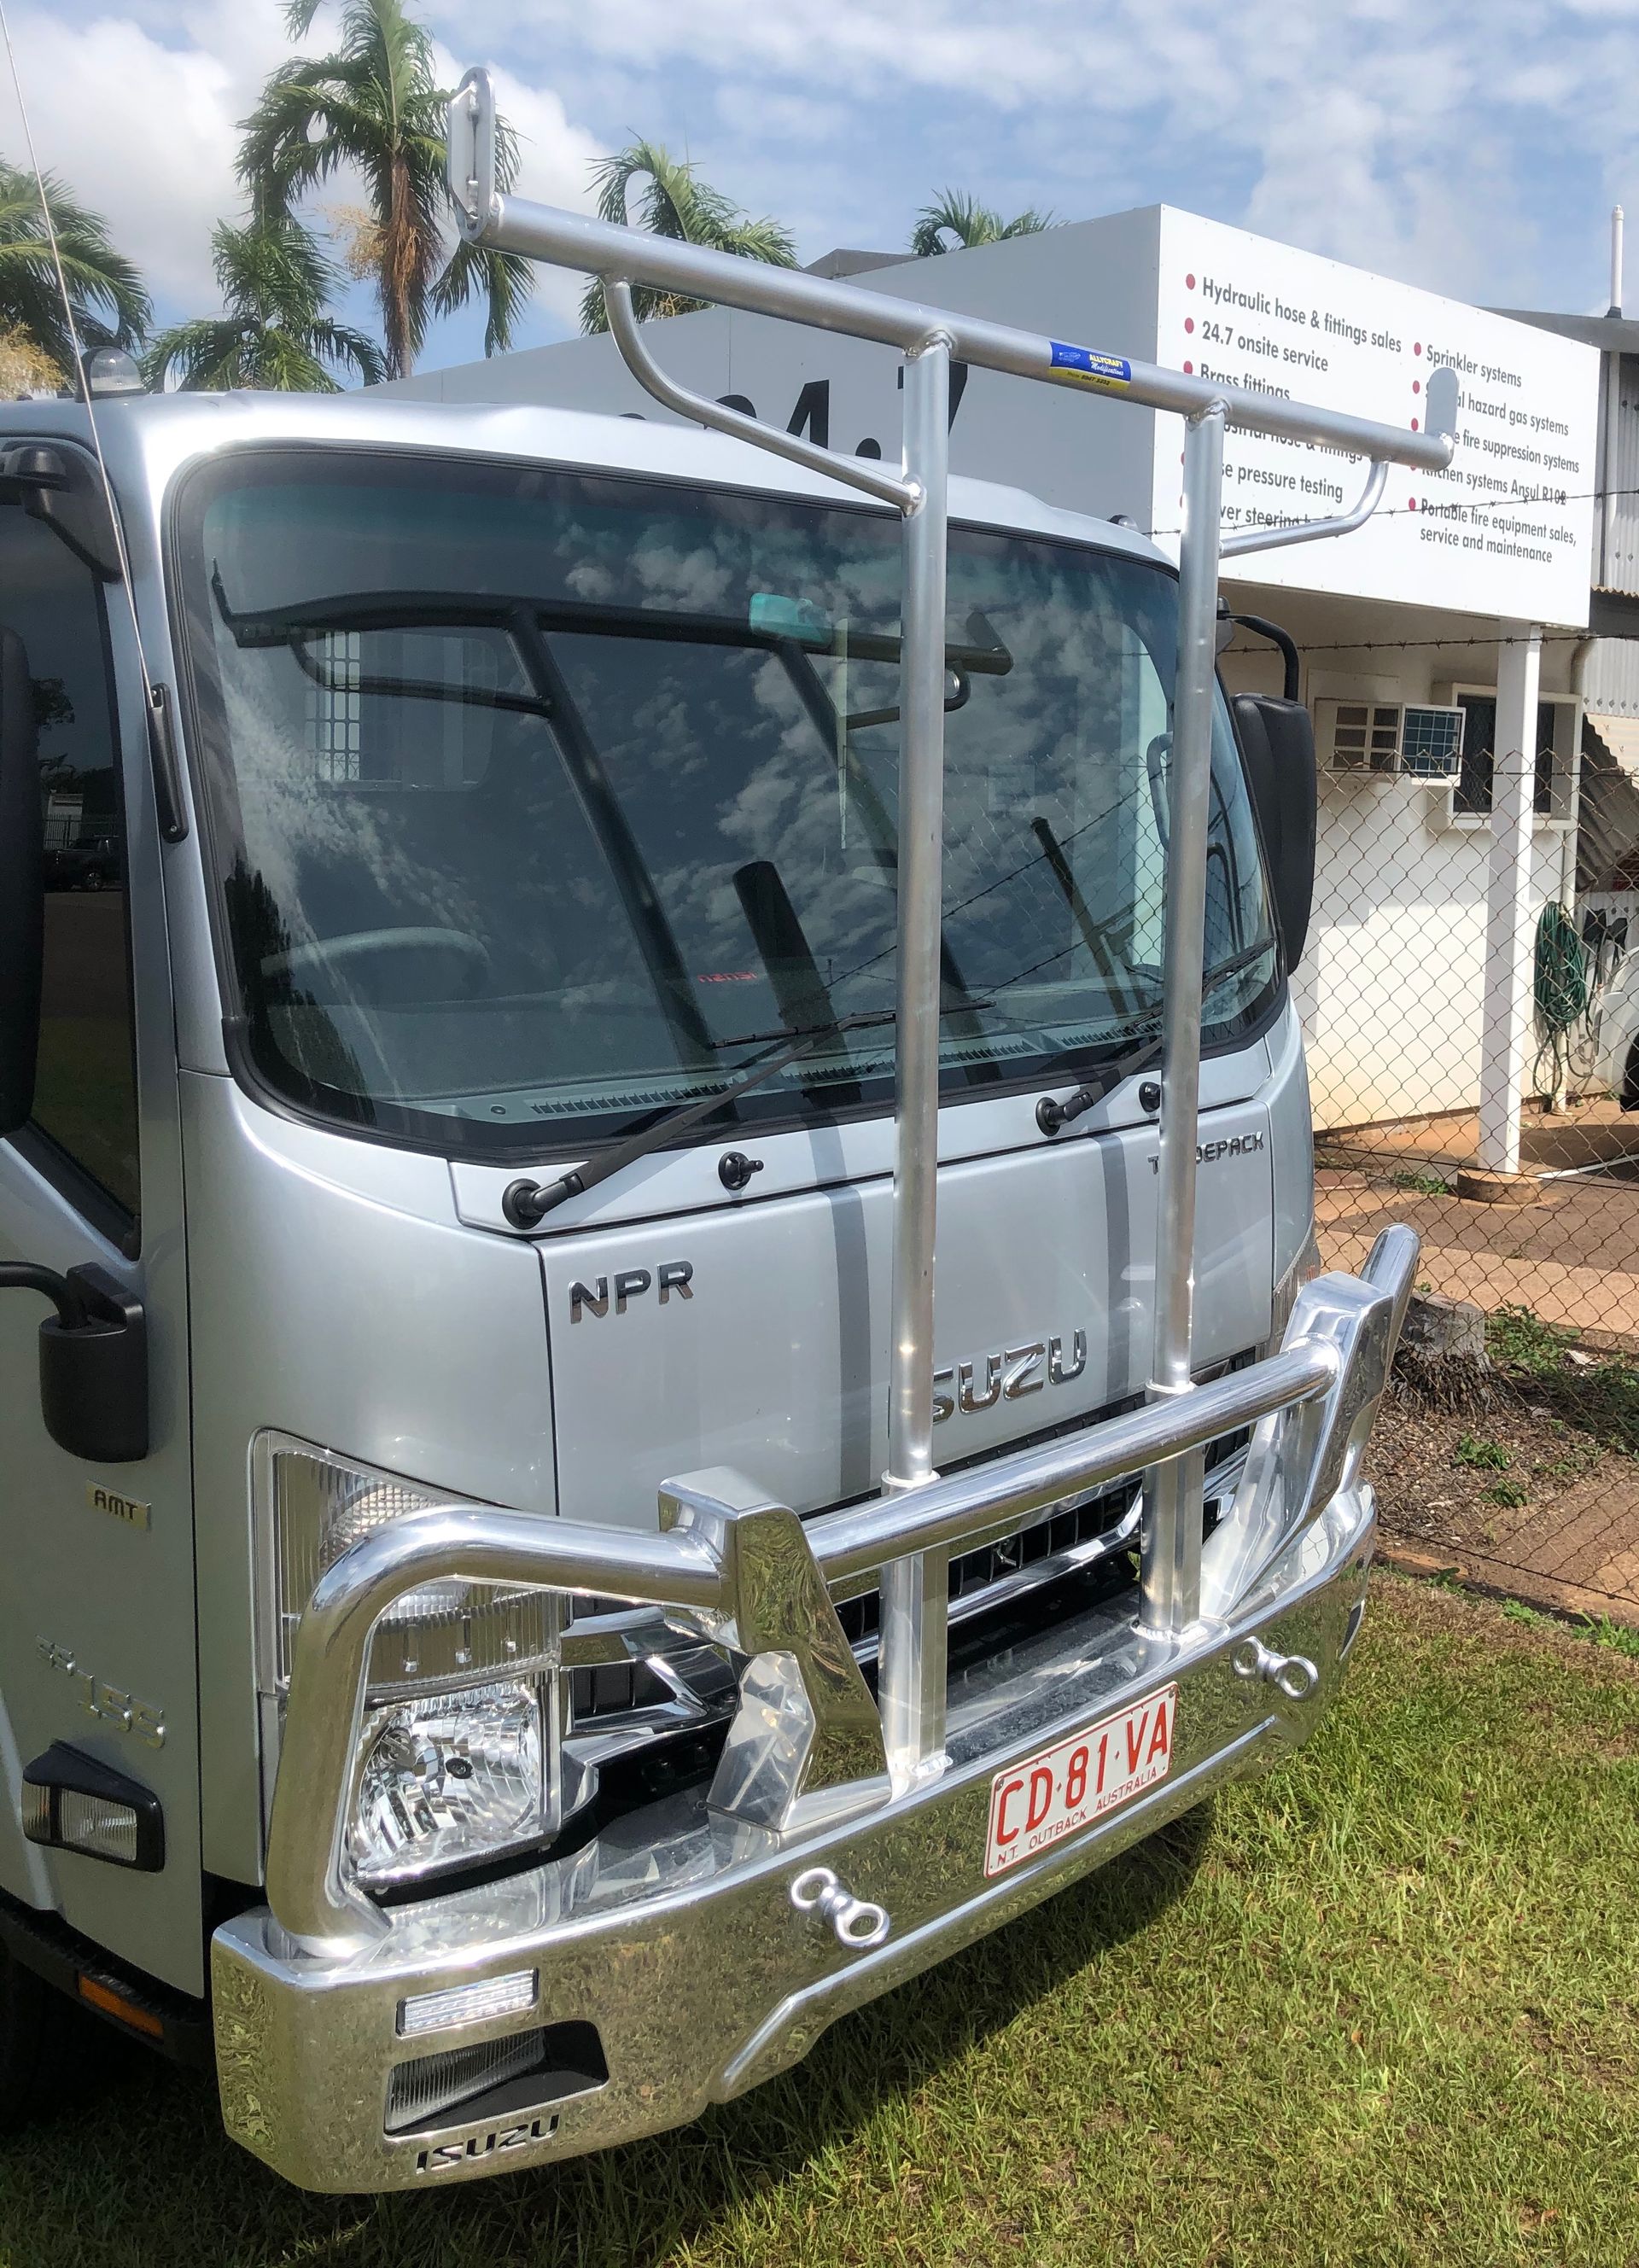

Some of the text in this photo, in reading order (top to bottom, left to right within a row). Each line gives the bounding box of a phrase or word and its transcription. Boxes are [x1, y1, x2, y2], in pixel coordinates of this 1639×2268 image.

[1203, 277, 1402, 353] Hydraulic hose & fittings sales
[1202, 320, 1328, 372] 24.7 onsite service
[1426, 344, 1522, 388] Sprinkler systems
[1200, 364, 1239, 388] Brass
[1468, 393, 1507, 419] hazard
[1509, 409, 1528, 426] gas
[1531, 415, 1569, 436] systems
[1463, 429, 1480, 449] fire
[1483, 439, 1541, 464] suppression
[1543, 454, 1580, 473] systems
[1238, 466, 1296, 490] pressure
[1300, 475, 1343, 504] testing
[1467, 473, 1508, 493] systems
[1511, 479, 1539, 501] Ansul
[1421, 498, 1577, 547] Portable fire equipment sales,
[1420, 528, 1553, 563] service and maintenance
[1147, 1131, 1264, 1175] TDEPACK
[568, 1260, 694, 1325] NPR
[888, 1326, 1088, 1441] SUZU
[94, 1489, 138, 1521] AMT
[1029, 1806, 1088, 1850] OUTBACK
[1094, 1766, 1158, 1814] AUSTRALIA
[417, 2113, 560, 2175] ISUZU
